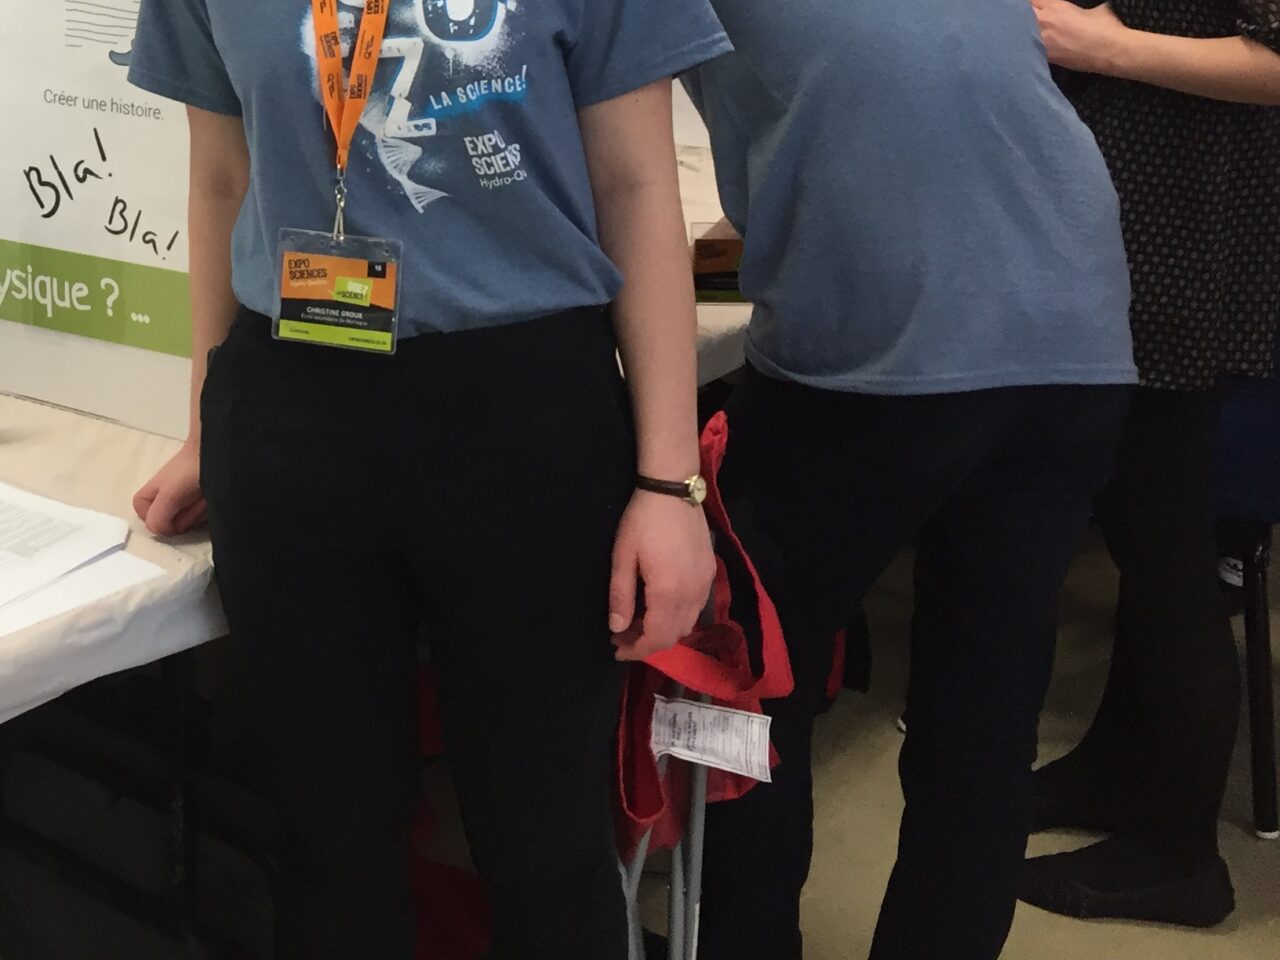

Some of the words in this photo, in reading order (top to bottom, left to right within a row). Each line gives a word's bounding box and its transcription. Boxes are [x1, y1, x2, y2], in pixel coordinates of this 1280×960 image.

[430, 90, 451, 110] LA
[457, 65, 527, 104] SCIENCE!
[44, 89, 78, 107] Créer
[82, 96, 107, 112] une
[110, 98, 164, 121] histoire.
[463, 129, 505, 155] EXPO
[24, 127, 112, 218] Bla!
[104, 196, 179, 260] Bla!
[288, 259, 309, 269] EXPO
[289, 269, 327, 280] SCIENCES
